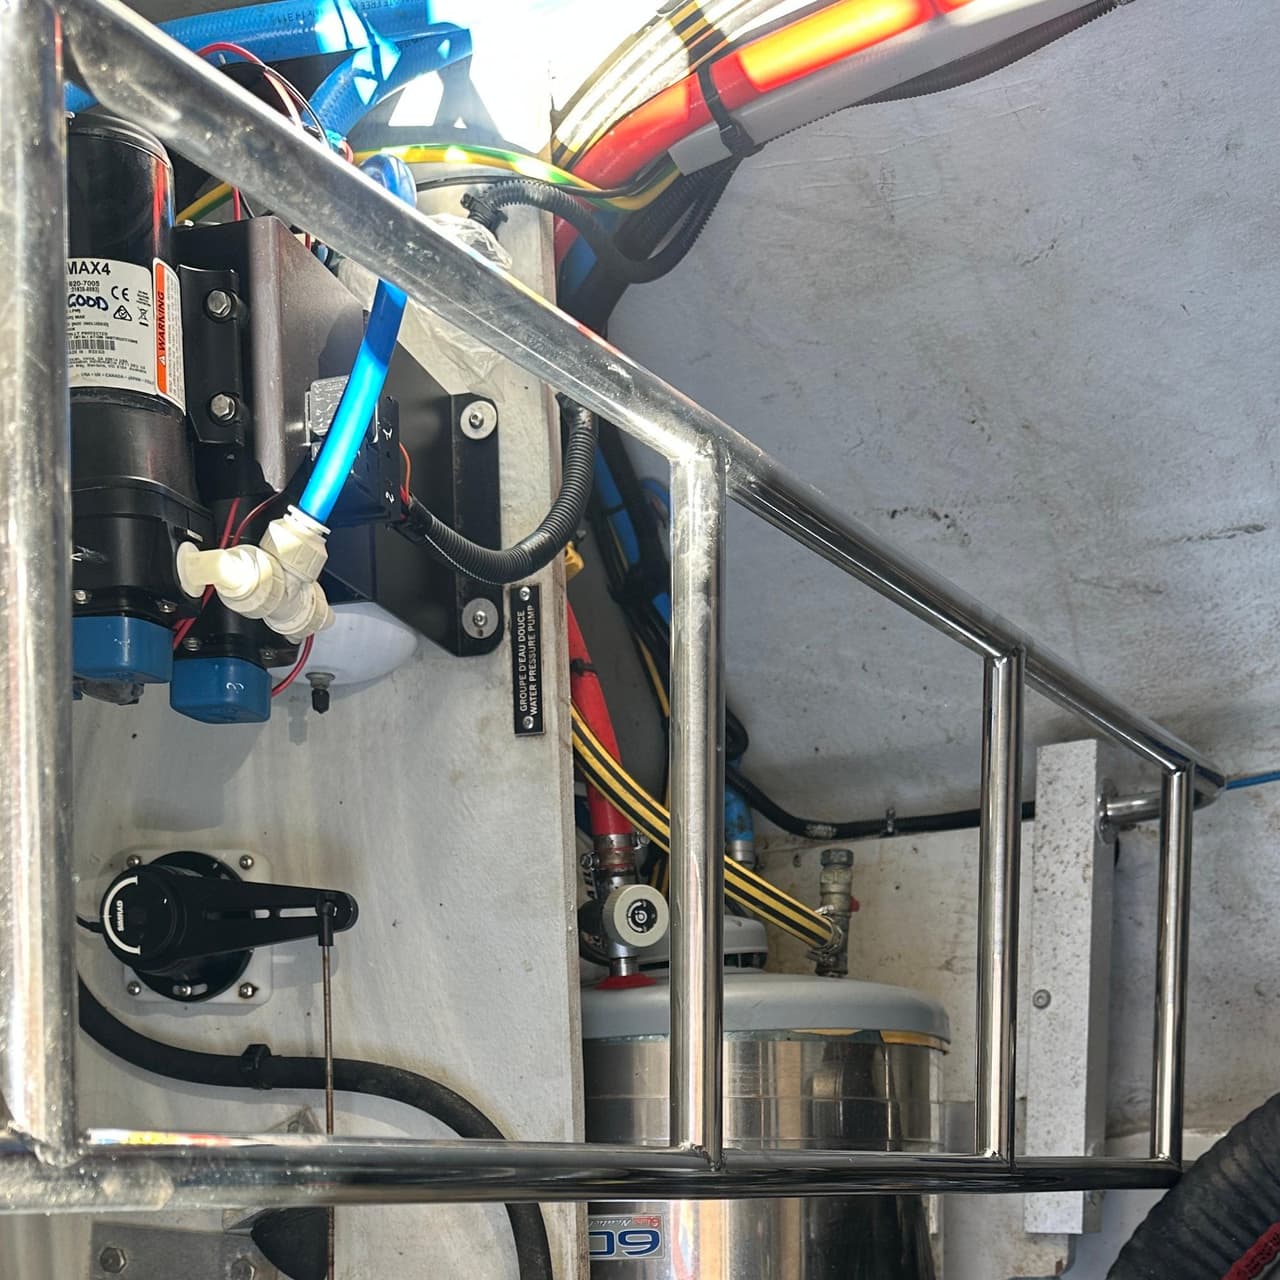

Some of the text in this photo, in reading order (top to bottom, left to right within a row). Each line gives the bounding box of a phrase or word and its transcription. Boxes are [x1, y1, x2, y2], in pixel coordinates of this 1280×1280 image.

[67, 261, 111, 275] MAX4
[67, 293, 109, 311] GOOD
[158, 291, 166, 352] WARNING
[517, 610, 528, 712] GROUPE D'EAU DOUCE
[527, 605, 538, 716] WATER PRESSURE PUMP
[116, 900, 124, 932] SIMRAD
